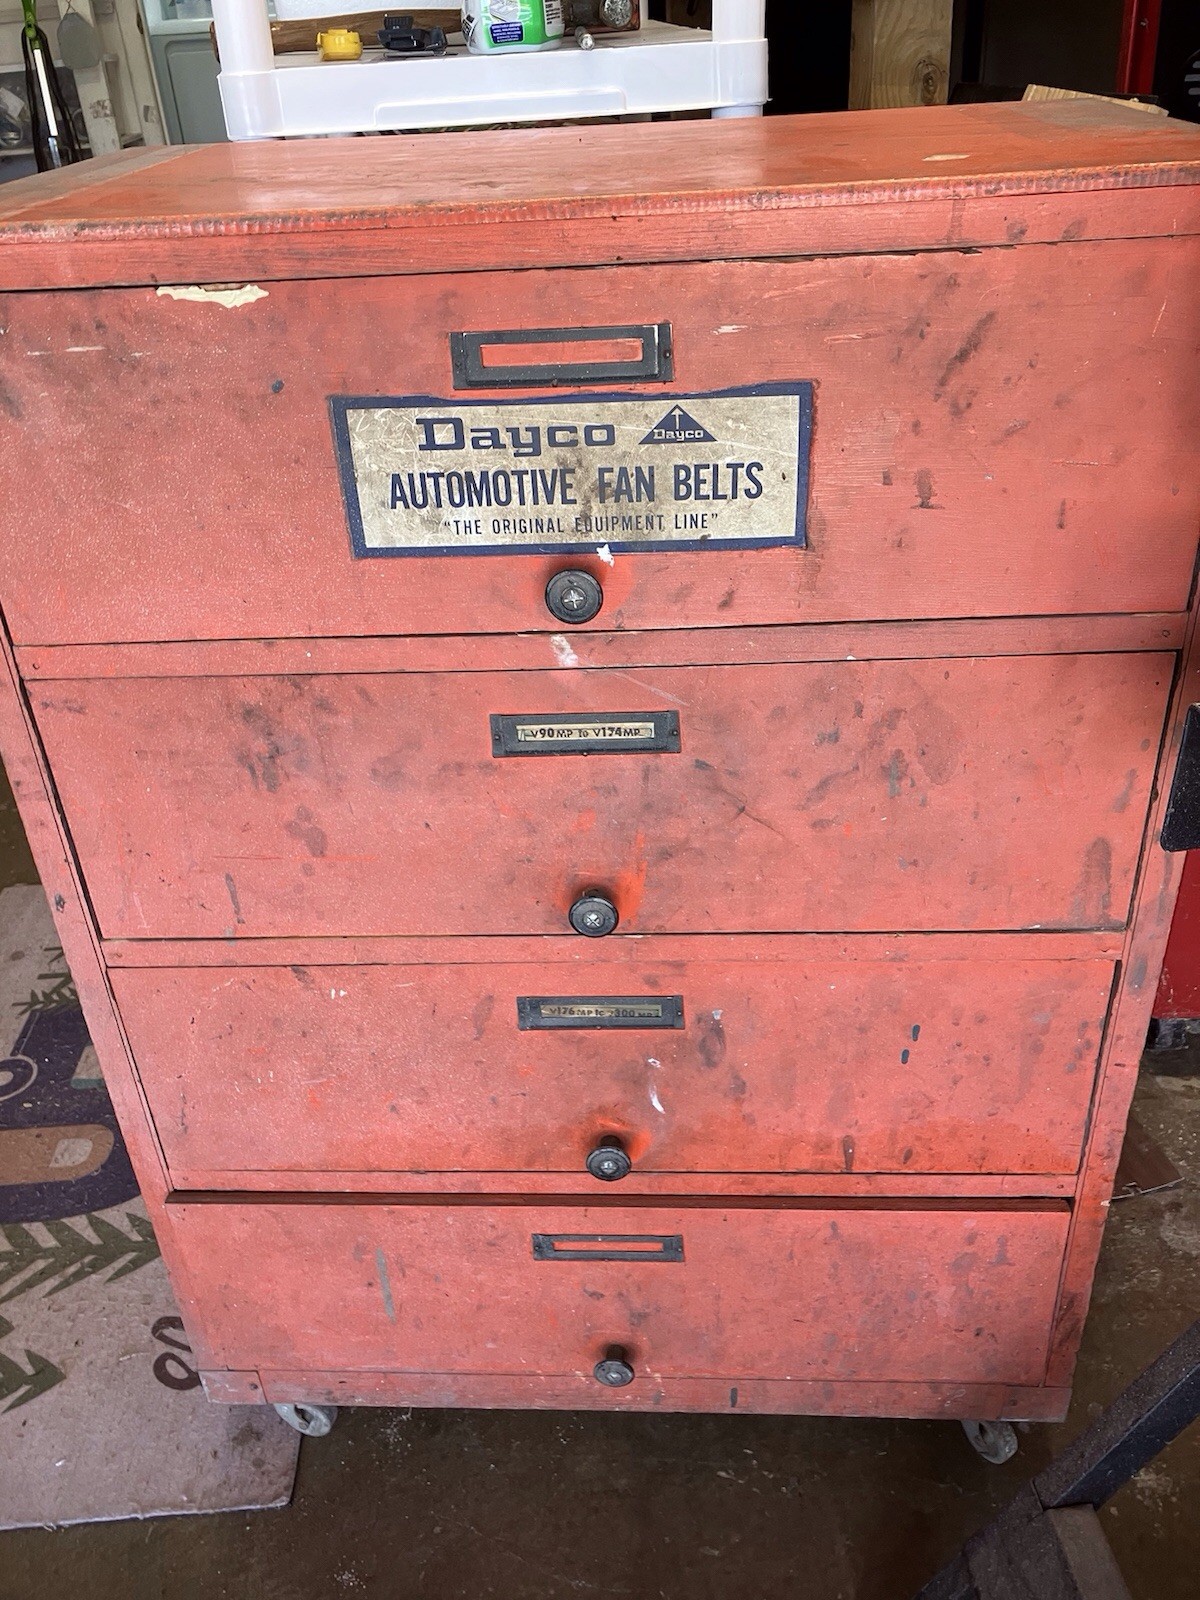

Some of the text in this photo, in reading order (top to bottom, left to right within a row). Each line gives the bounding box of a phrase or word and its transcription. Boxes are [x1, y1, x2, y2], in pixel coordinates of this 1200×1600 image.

[415, 416, 616, 457] Dayco
[653, 428, 704, 442] Dayco
[389, 461, 764, 510] AUTOMOTIVE FAN BELTS
[492, 517, 564, 534] ORIGINAL
[574, 514, 665, 533] EQUIPMENT
